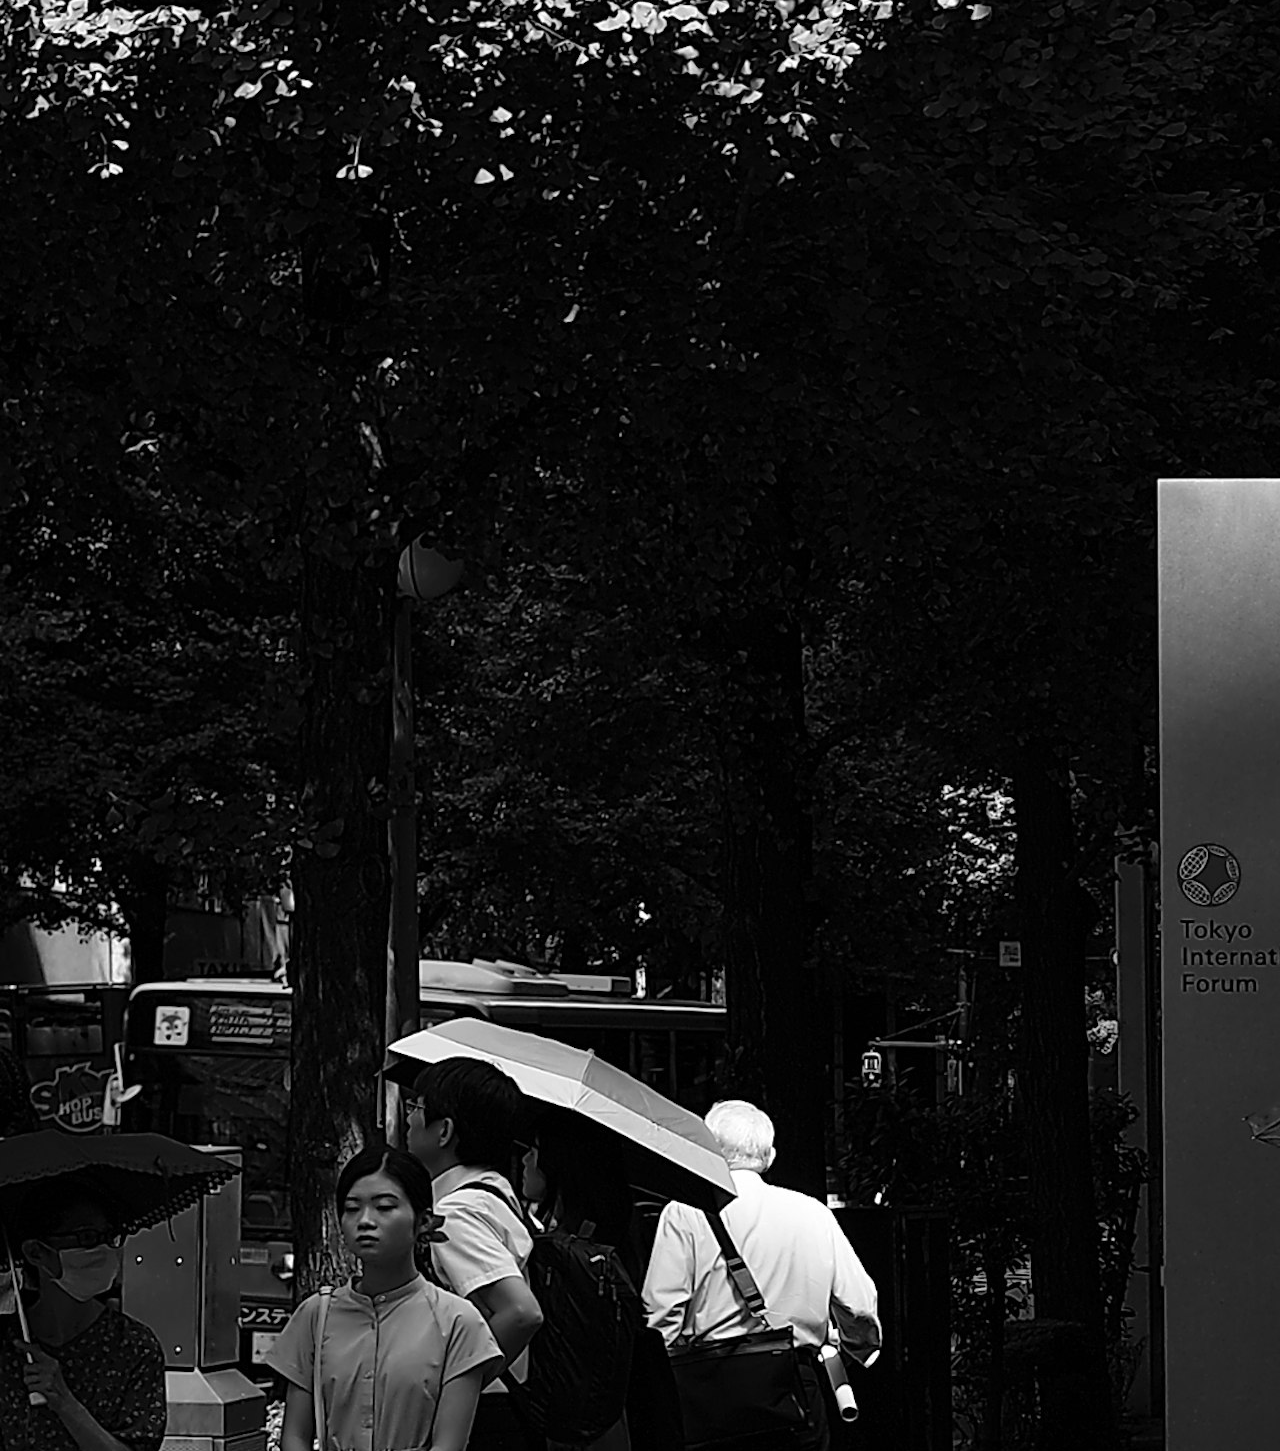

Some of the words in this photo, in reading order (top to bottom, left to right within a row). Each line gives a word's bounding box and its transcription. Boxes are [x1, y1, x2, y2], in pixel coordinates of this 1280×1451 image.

[1180, 919, 1252, 944] Tokyo
[198, 962, 238, 976] TAXI
[1182, 974, 1258, 992] Forum
[58, 1096, 93, 1116] HOP
[71, 1106, 103, 1126] BUS
[241, 1307, 293, 1325] ンステ
